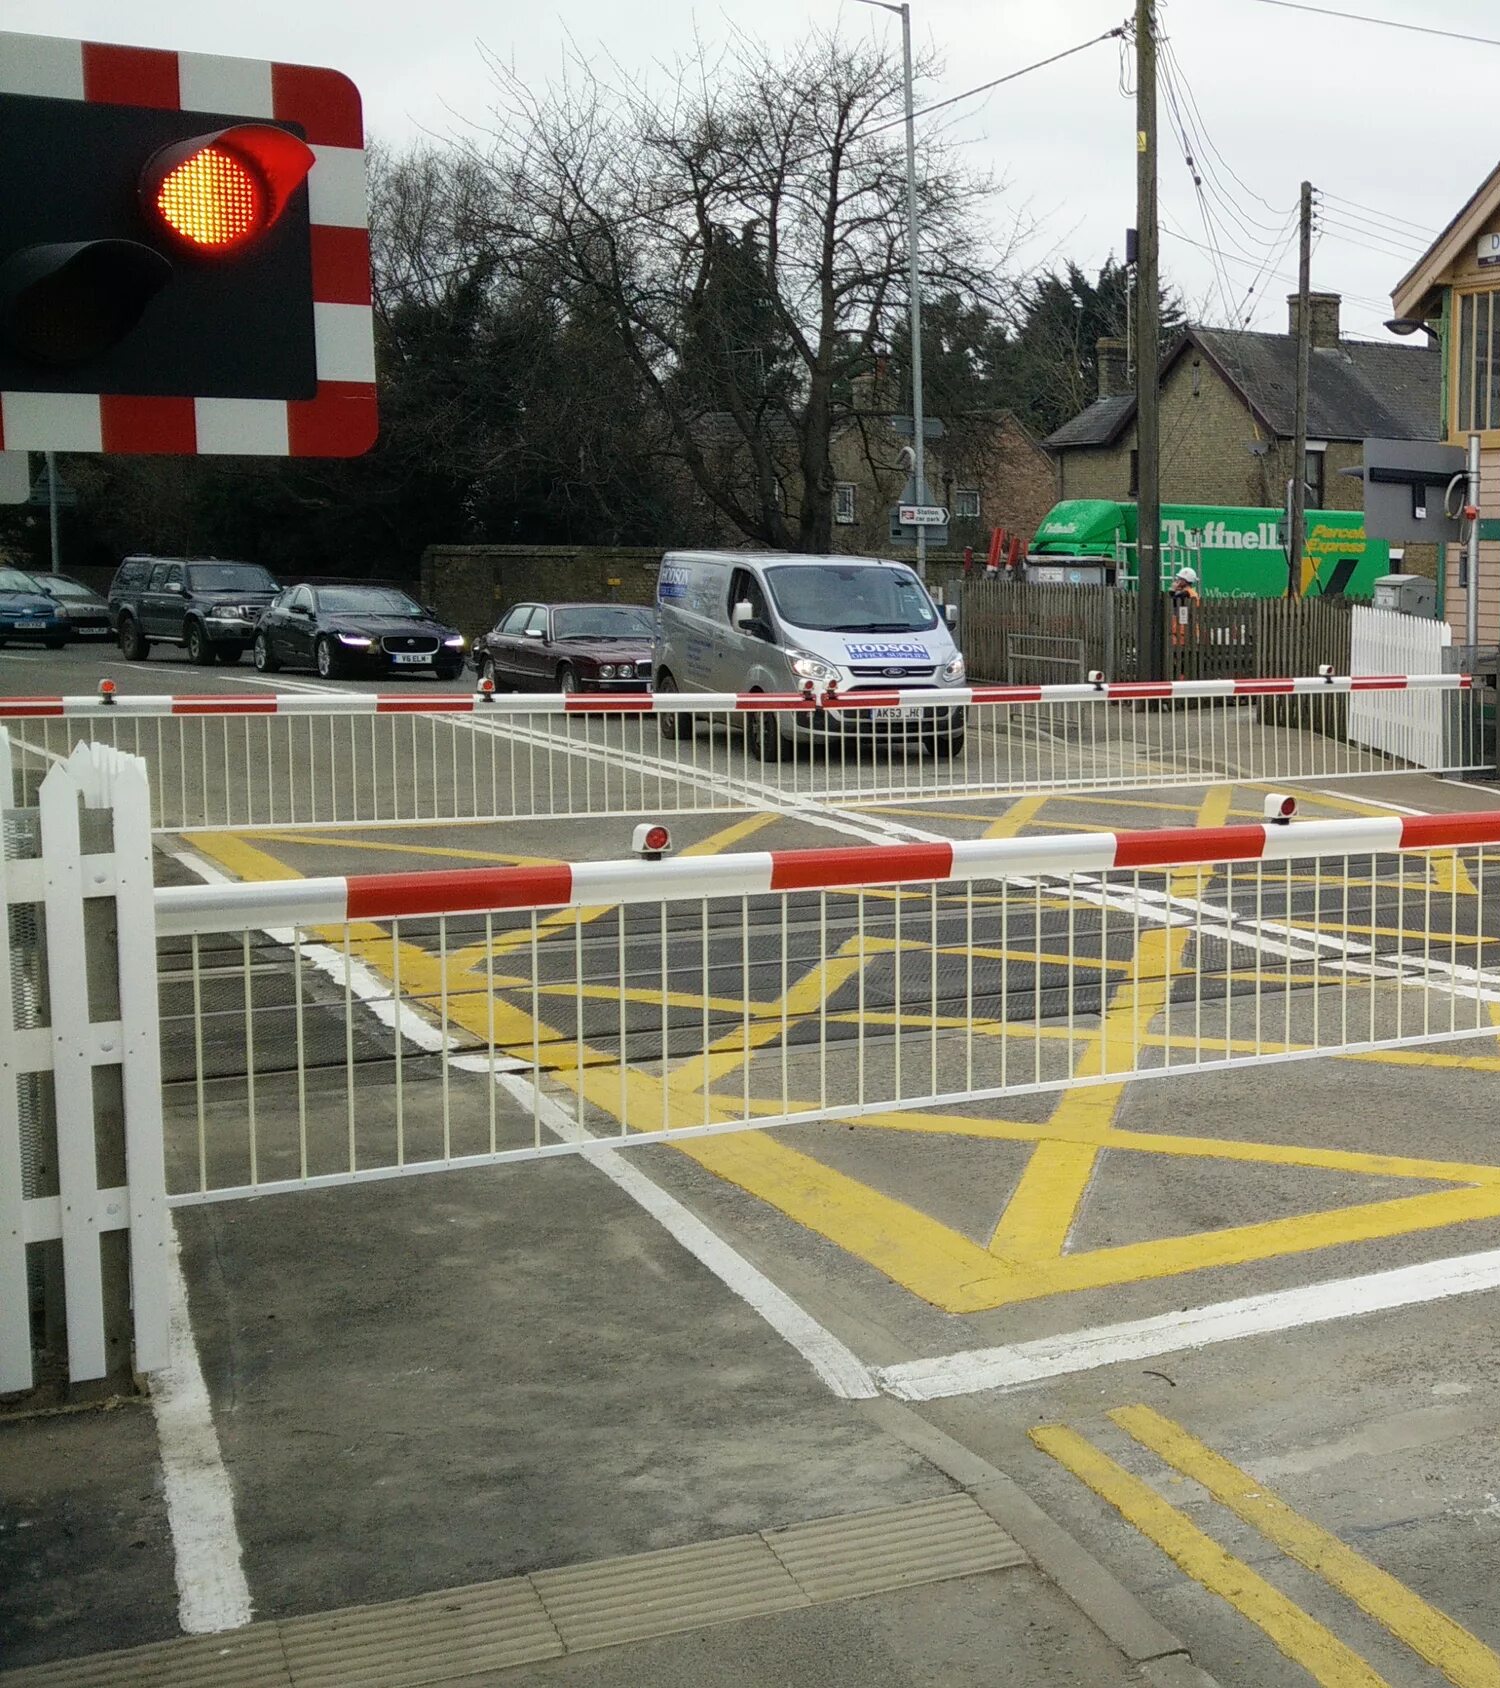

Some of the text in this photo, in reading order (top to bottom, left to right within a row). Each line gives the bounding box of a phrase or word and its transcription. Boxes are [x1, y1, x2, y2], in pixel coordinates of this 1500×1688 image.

[1161, 519, 1290, 550] Tuffnell
[1304, 537, 1367, 554] Express
[660, 567, 689, 585] HODSON
[847, 644, 927, 653] HODSON
[852, 652, 930, 660] OFFICE SUPPLIES
